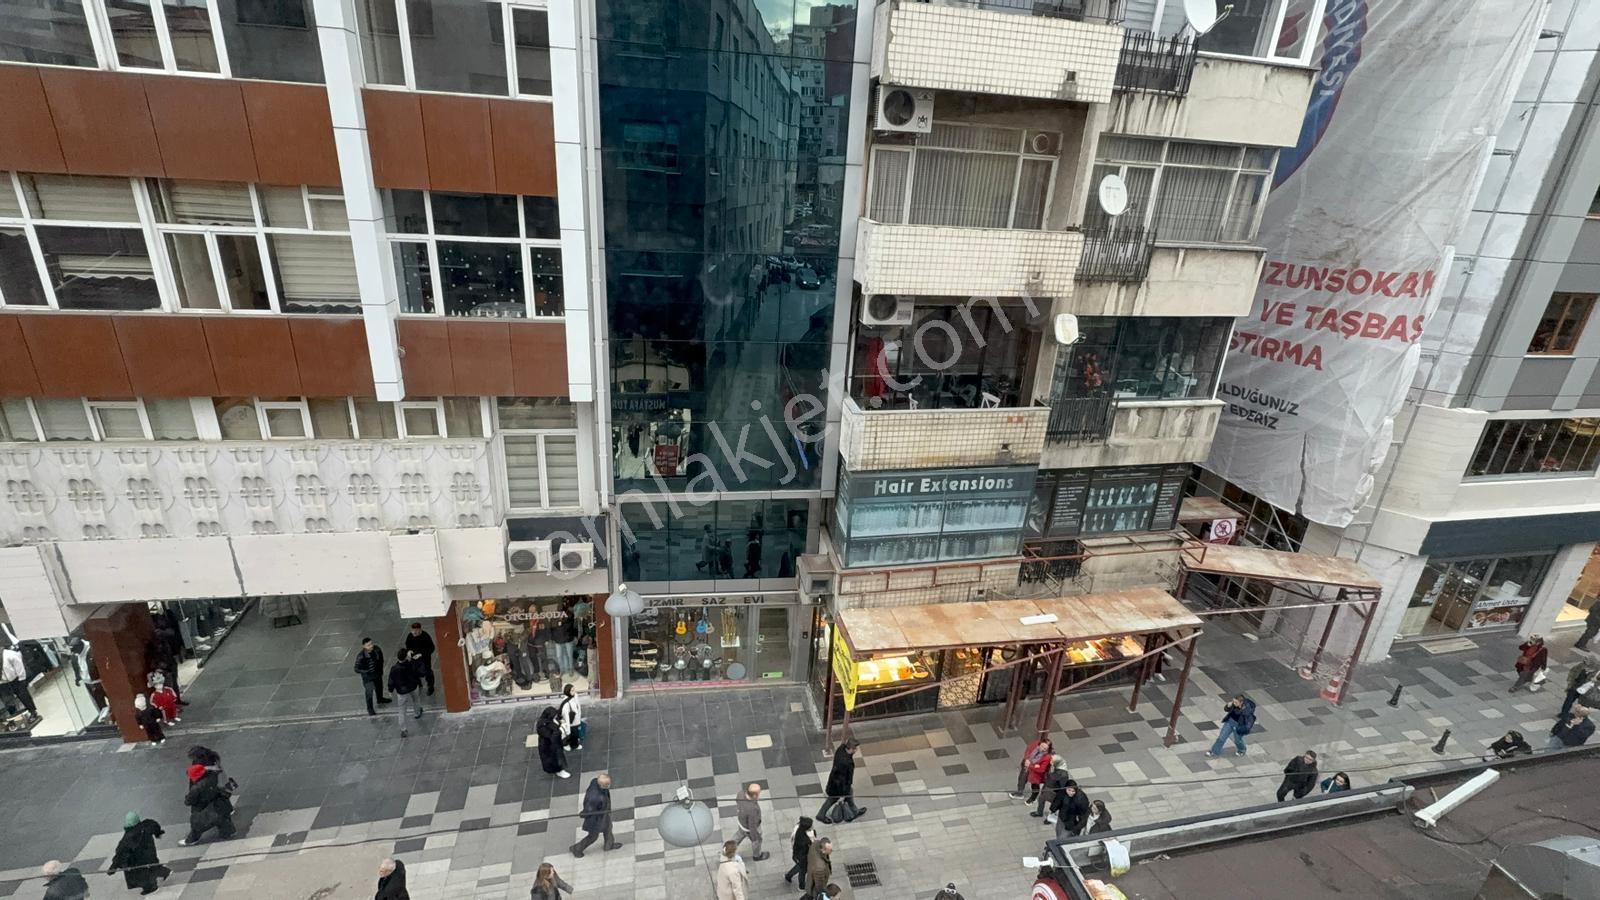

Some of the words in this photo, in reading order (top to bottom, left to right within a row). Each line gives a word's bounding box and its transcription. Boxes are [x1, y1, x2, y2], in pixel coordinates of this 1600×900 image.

[1260, 261, 1436, 298] ZUNSOKA
[1260, 299, 1296, 326] VE
[1230, 403, 1279, 430] EDERİZ
[874, 478, 914, 496] Hair
[920, 475, 1014, 493] Extensions
[702, 596, 726, 605] SAZ
